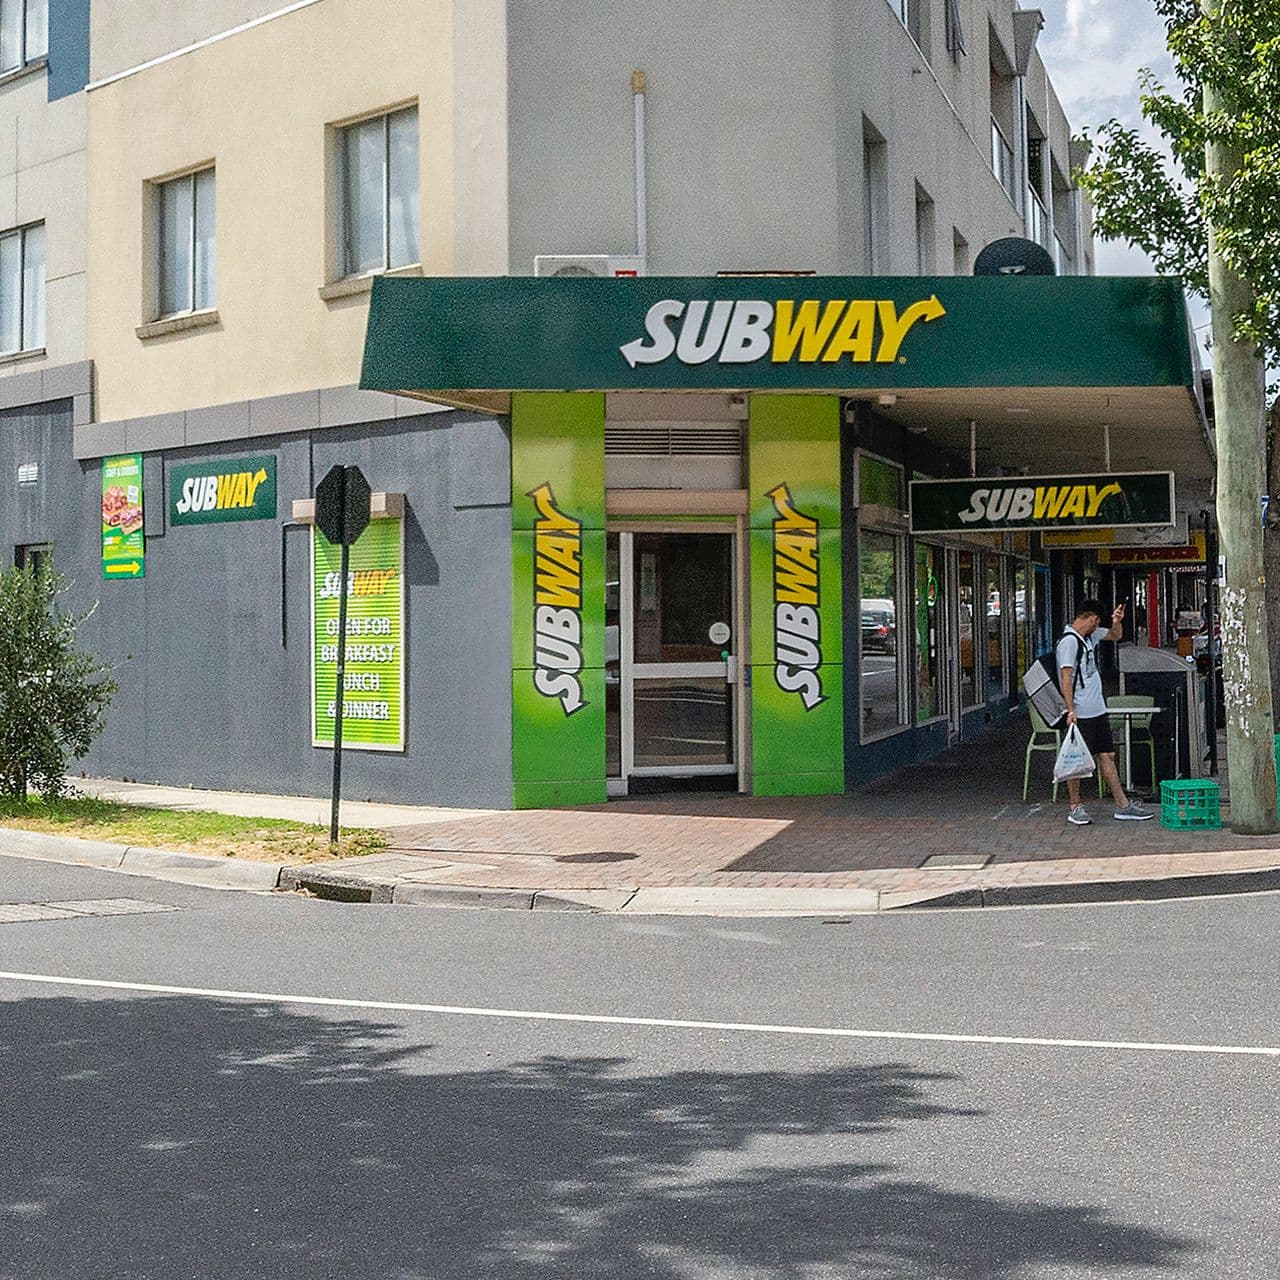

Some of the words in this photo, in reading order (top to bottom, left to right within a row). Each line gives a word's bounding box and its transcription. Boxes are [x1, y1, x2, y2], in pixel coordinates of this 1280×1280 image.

[620, 295, 946, 368] SUBWAY
[176, 468, 267, 515] SUBWAY
[957, 482, 1121, 524] SUBWAY
[526, 482, 589, 717] SUBWAY
[765, 482, 828, 712] SUBWAY
[326, 618, 361, 635] OEN
[364, 617, 391, 635] FOR
[321, 644, 395, 663] BRAKFAST
[342, 673, 381, 692] UNCH
